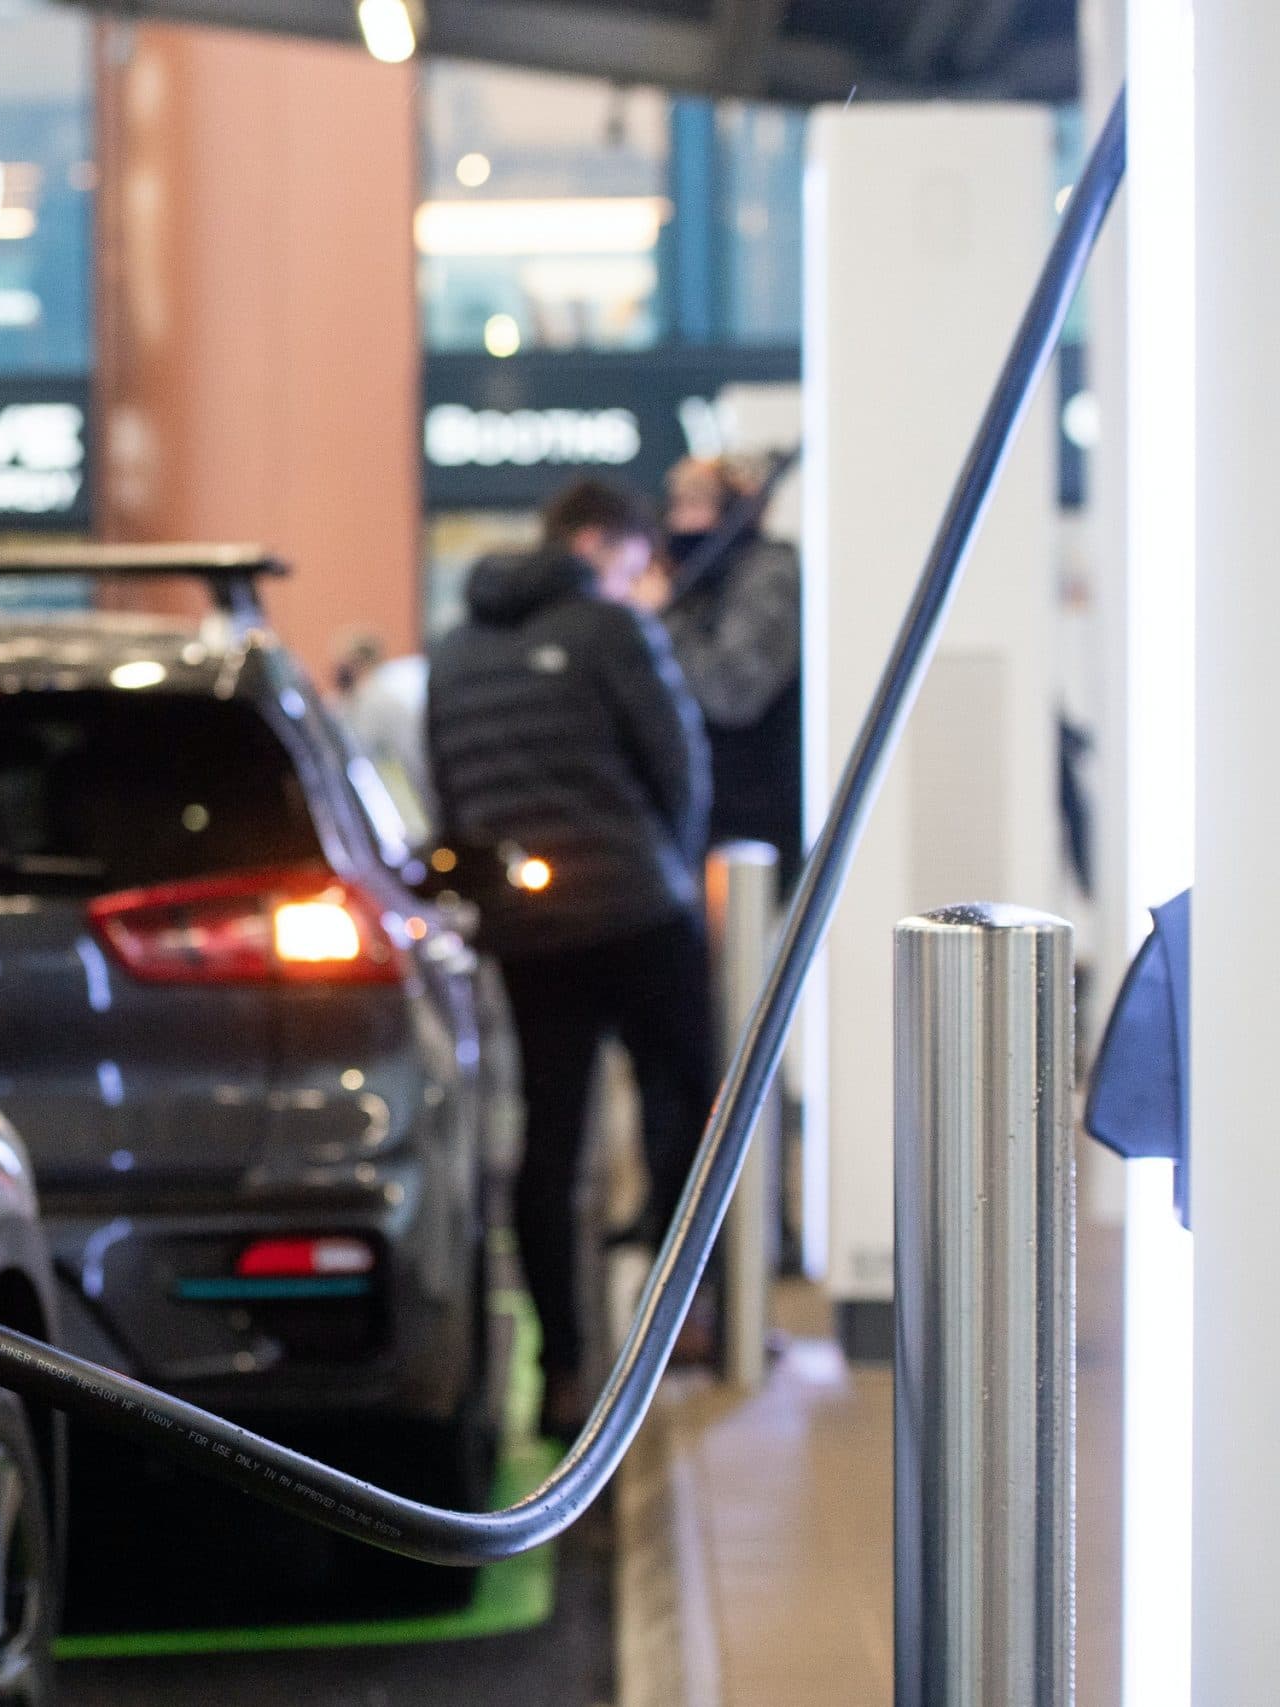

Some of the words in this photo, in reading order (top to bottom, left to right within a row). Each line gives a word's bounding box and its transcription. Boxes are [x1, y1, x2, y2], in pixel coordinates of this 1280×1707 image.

[36, 1359, 73, 1383] RADOX
[188, 1431, 209, 1448] FOR
[211, 1441, 233, 1459] USE
[235, 1453, 261, 1471] ONLY
[263, 1467, 277, 1480] IN
